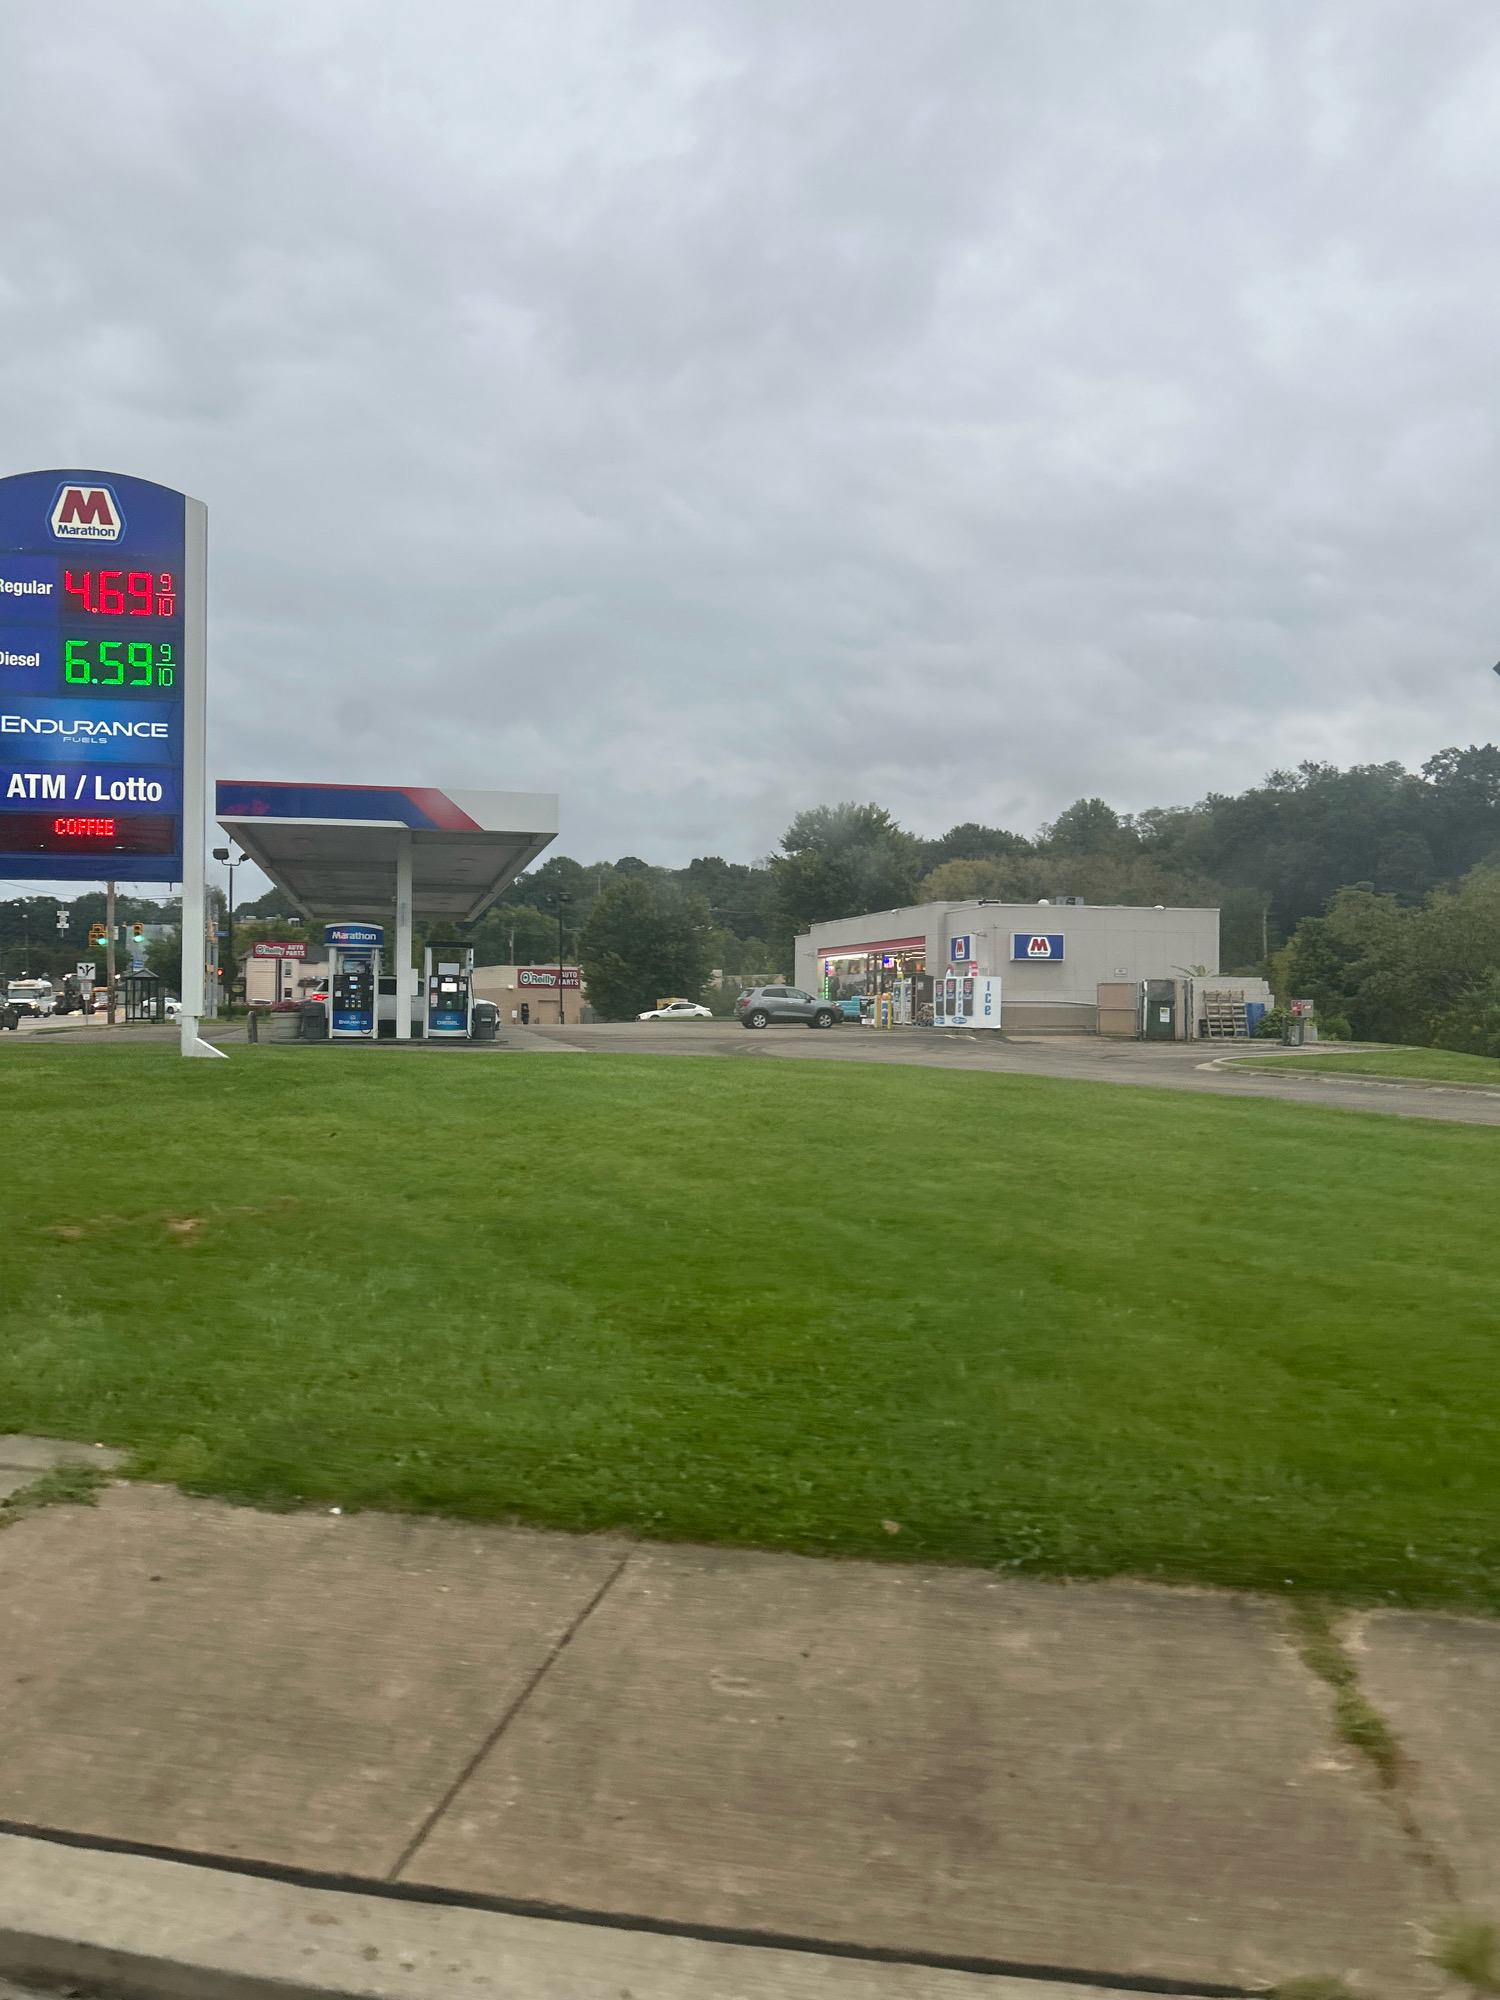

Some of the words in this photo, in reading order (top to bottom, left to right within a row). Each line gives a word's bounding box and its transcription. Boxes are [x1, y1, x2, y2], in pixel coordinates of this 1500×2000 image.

[58, 490, 114, 525] M
[57, 525, 116, 537] Marathon
[64, 570, 152, 615] 4.69
[65, 640, 152, 686] 6.59
[1, 715, 169, 738] ENDURANCE
[63, 736, 107, 744] FUELS
[6, 773, 66, 799] ATM
[95, 775, 163, 802] Lotto
[54, 818, 115, 836] COFFEE
[332, 931, 377, 940] Marathon
[520, 971, 557, 986] O'Reilly
